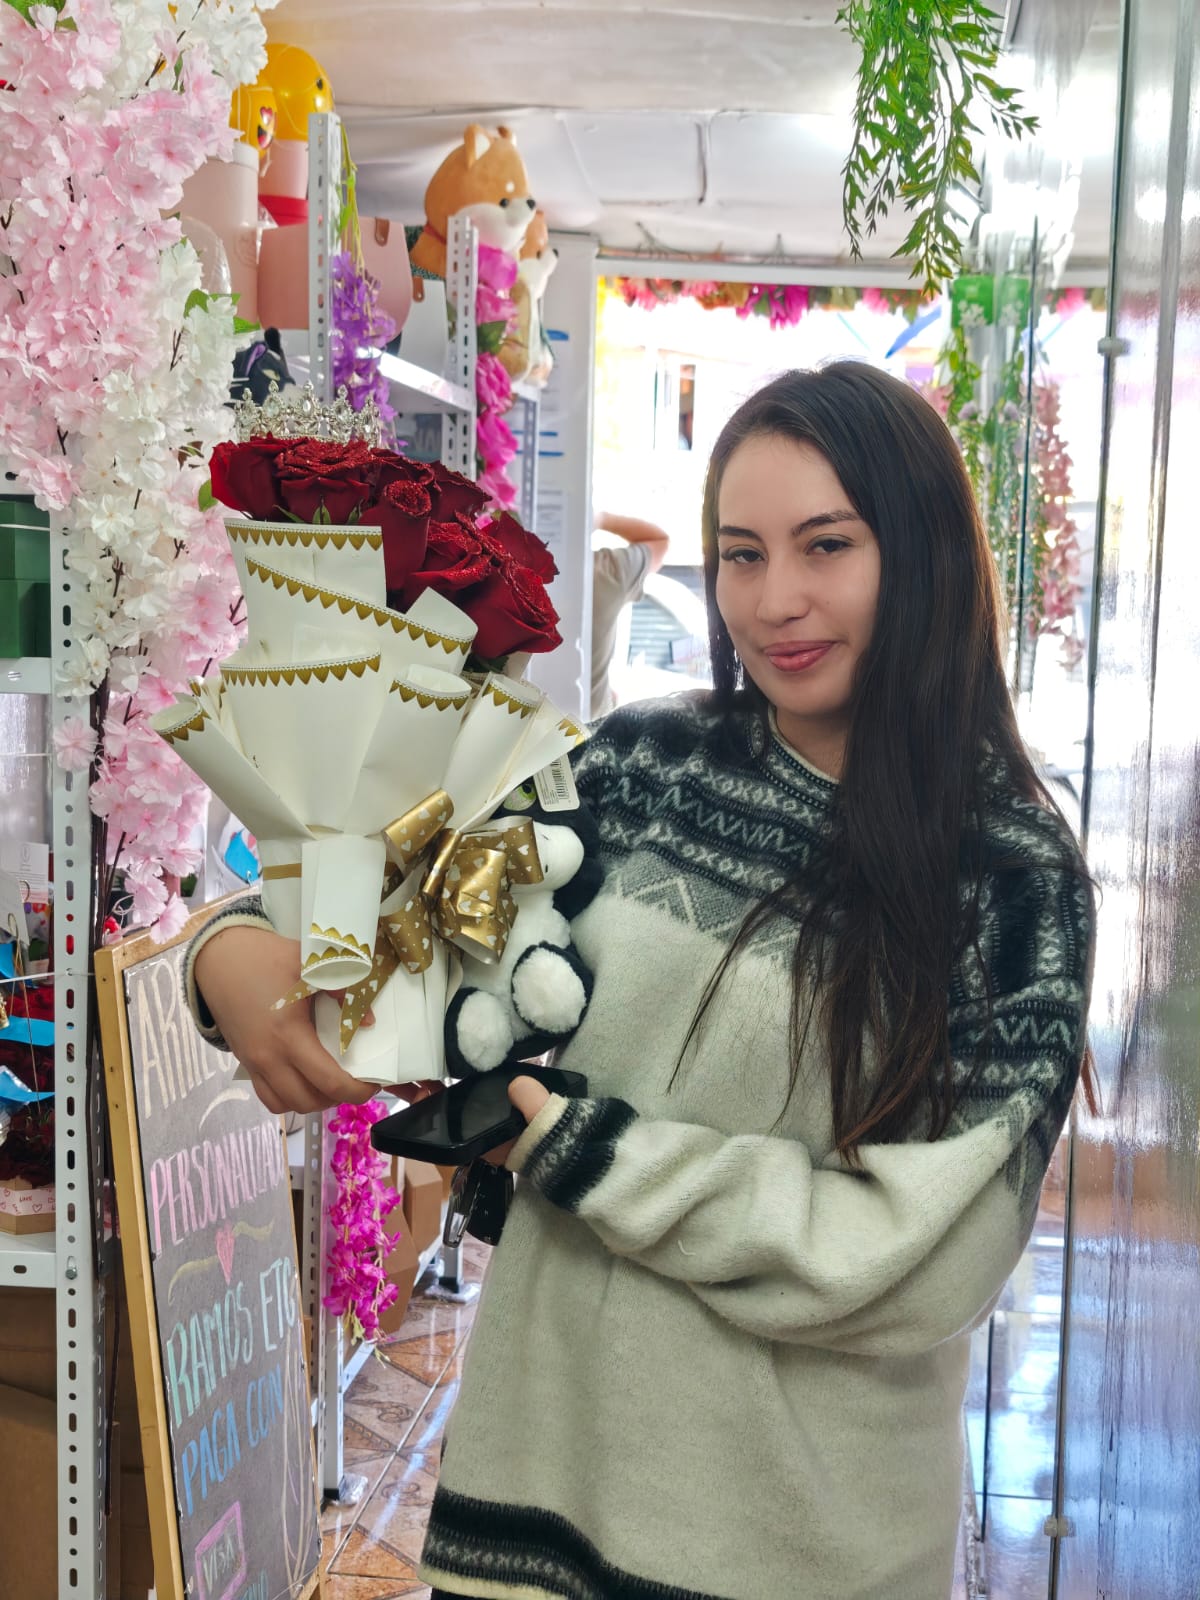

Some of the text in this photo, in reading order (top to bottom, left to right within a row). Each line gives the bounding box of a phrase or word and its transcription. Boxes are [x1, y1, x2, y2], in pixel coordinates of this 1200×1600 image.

[166, 1256, 297, 1429] RAMOS ETC
[181, 1363, 284, 1517] PAGA CON
[202, 1531, 236, 1595] VISA
